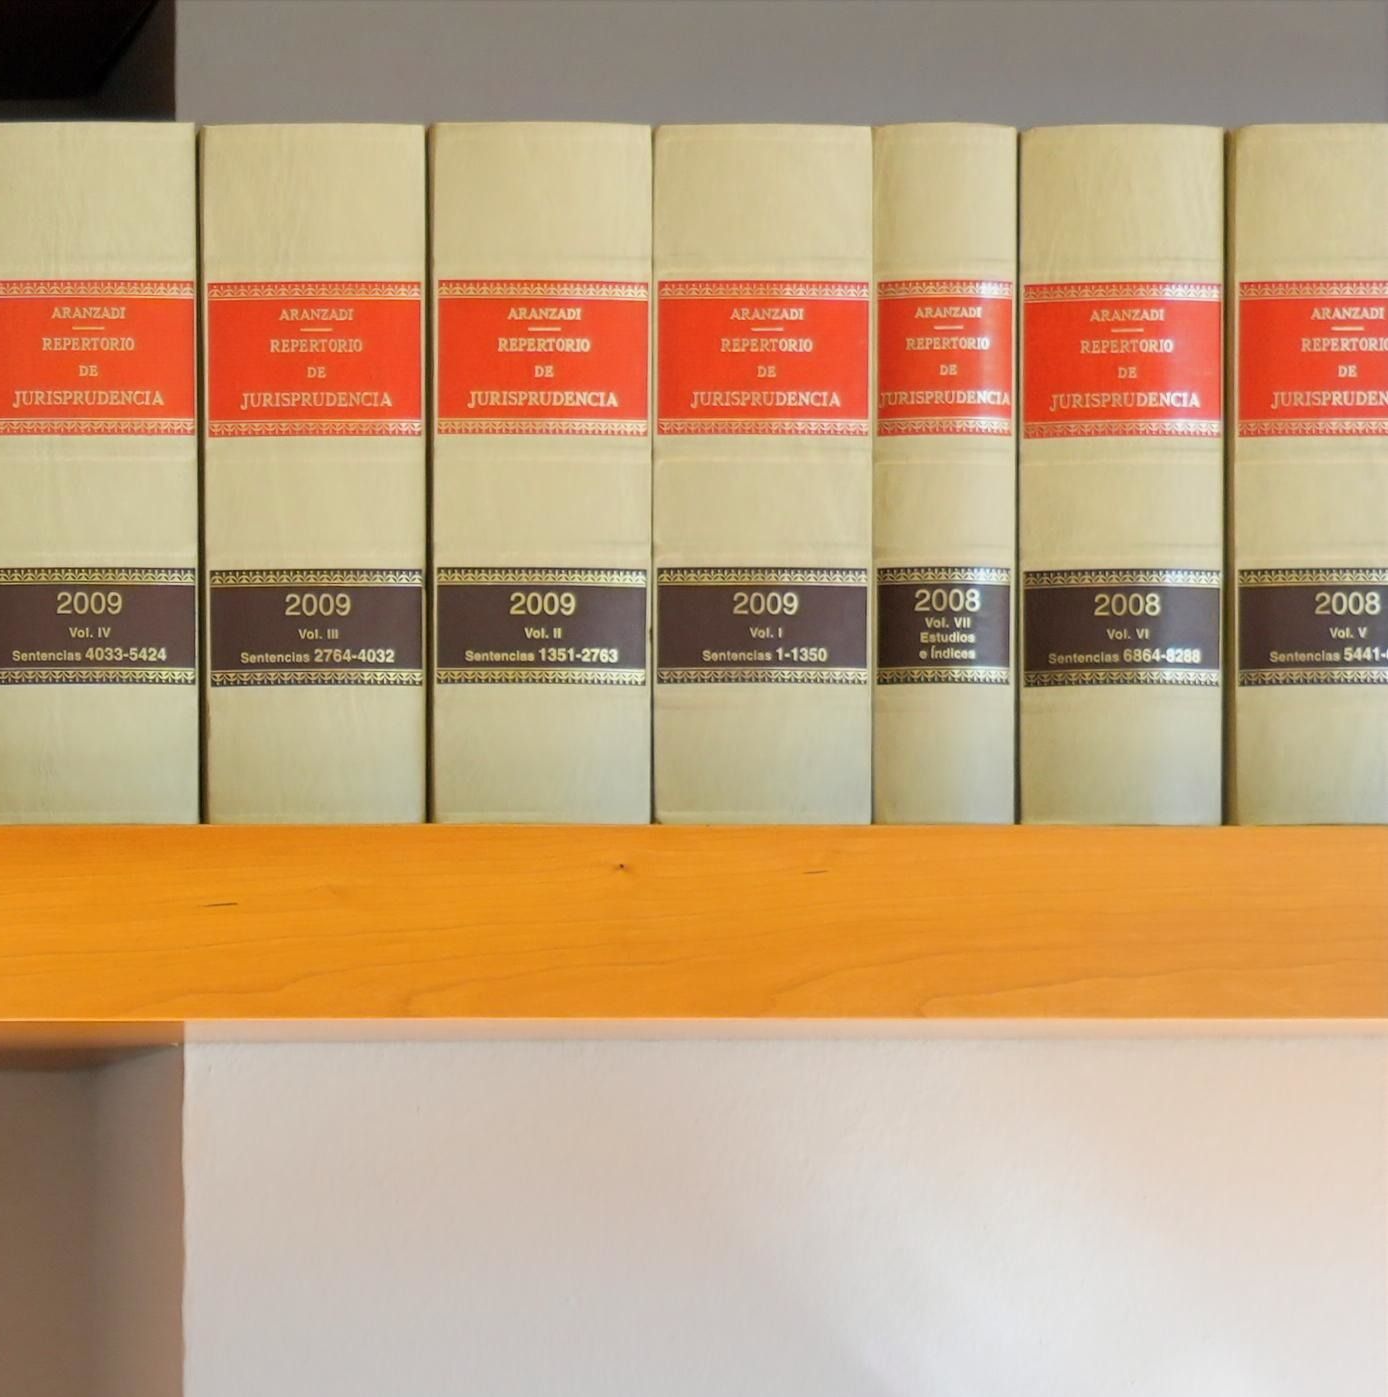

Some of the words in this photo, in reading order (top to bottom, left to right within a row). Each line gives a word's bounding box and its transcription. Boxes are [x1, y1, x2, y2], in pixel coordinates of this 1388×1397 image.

[51, 307, 126, 319] ARANZADI
[279, 308, 353, 321] ARANZADI
[507, 308, 581, 320] ARANZADI
[730, 308, 804, 320] ARANZADI
[914, 306, 982, 318] ARANZADI
[1090, 309, 1165, 322] ARANZADI
[1311, 306, 1384, 319] ARANZADI
[42, 337, 135, 351] REPERTORIO
[270, 339, 362, 353] REPERTORIO
[497, 338, 590, 352] REPERTORIO
[720, 339, 813, 352] REPERTORIO
[905, 337, 990, 350] REPERTORIO
[1080, 340, 1173, 354] REPERTORIO
[78, 365, 97, 377] DE
[307, 366, 326, 378] DE
[534, 365, 554, 377] DE
[757, 366, 776, 377] DE
[939, 364, 957, 375] DE
[1118, 367, 1137, 379] DE
[1338, 365, 1357, 377] DE
[12, 390, 164, 409] JURISPRUDENCIA
[240, 392, 392, 411] JURISPRUDENCIA
[467, 390, 618, 408] JURISPRUDENCIA
[691, 391, 841, 409] JURISPRUDENCIA
[879, 390, 1011, 407] JURISPRUDENCIA
[1049, 392, 1200, 411] JURISPRUDENCIA
[56, 592, 123, 616] 2009
[285, 594, 351, 617] 2009
[509, 592, 576, 615] 2009
[732, 592, 799, 615] 2009
[914, 589, 981, 612] 2008
[1094, 593, 1161, 616] 2008
[1314, 591, 1380, 615] 2008
[925, 616, 950, 628] Vol.
[953, 616, 971, 628] VII
[69, 627, 95, 639] Vol.
[99, 627, 111, 638] IV
[298, 629, 324, 640] Vol.
[327, 629, 338, 640] III
[525, 627, 551, 639] Vol.
[553, 627, 562, 639] II
[750, 627, 775, 638] Vol.
[778, 627, 782, 638] I
[920, 631, 975, 643] Estudios
[1107, 628, 1134, 640] Vol.
[1136, 627, 1149, 639] VI
[1329, 627, 1355, 638] Vol.
[1358, 627, 1367, 638] V
[12, 649, 82, 662] Sentencias
[85, 646, 167, 662] 4033-5424
[240, 650, 310, 663] Sentencias
[314, 648, 395, 663] 2764-4032
[465, 649, 535, 661] Sentencias
[538, 648, 618, 662] 1351-2763
[703, 649, 772, 661] Sentencias
[775, 647, 827, 662] 1-1350
[919, 650, 927, 659] e
[930, 645, 975, 659] Índices
[1048, 652, 1119, 664] Sentencias
[1123, 649, 1201, 664] 6864-8288
[1269, 650, 1340, 663] Sentencias
[1343, 647, 1388, 663] 5441-
